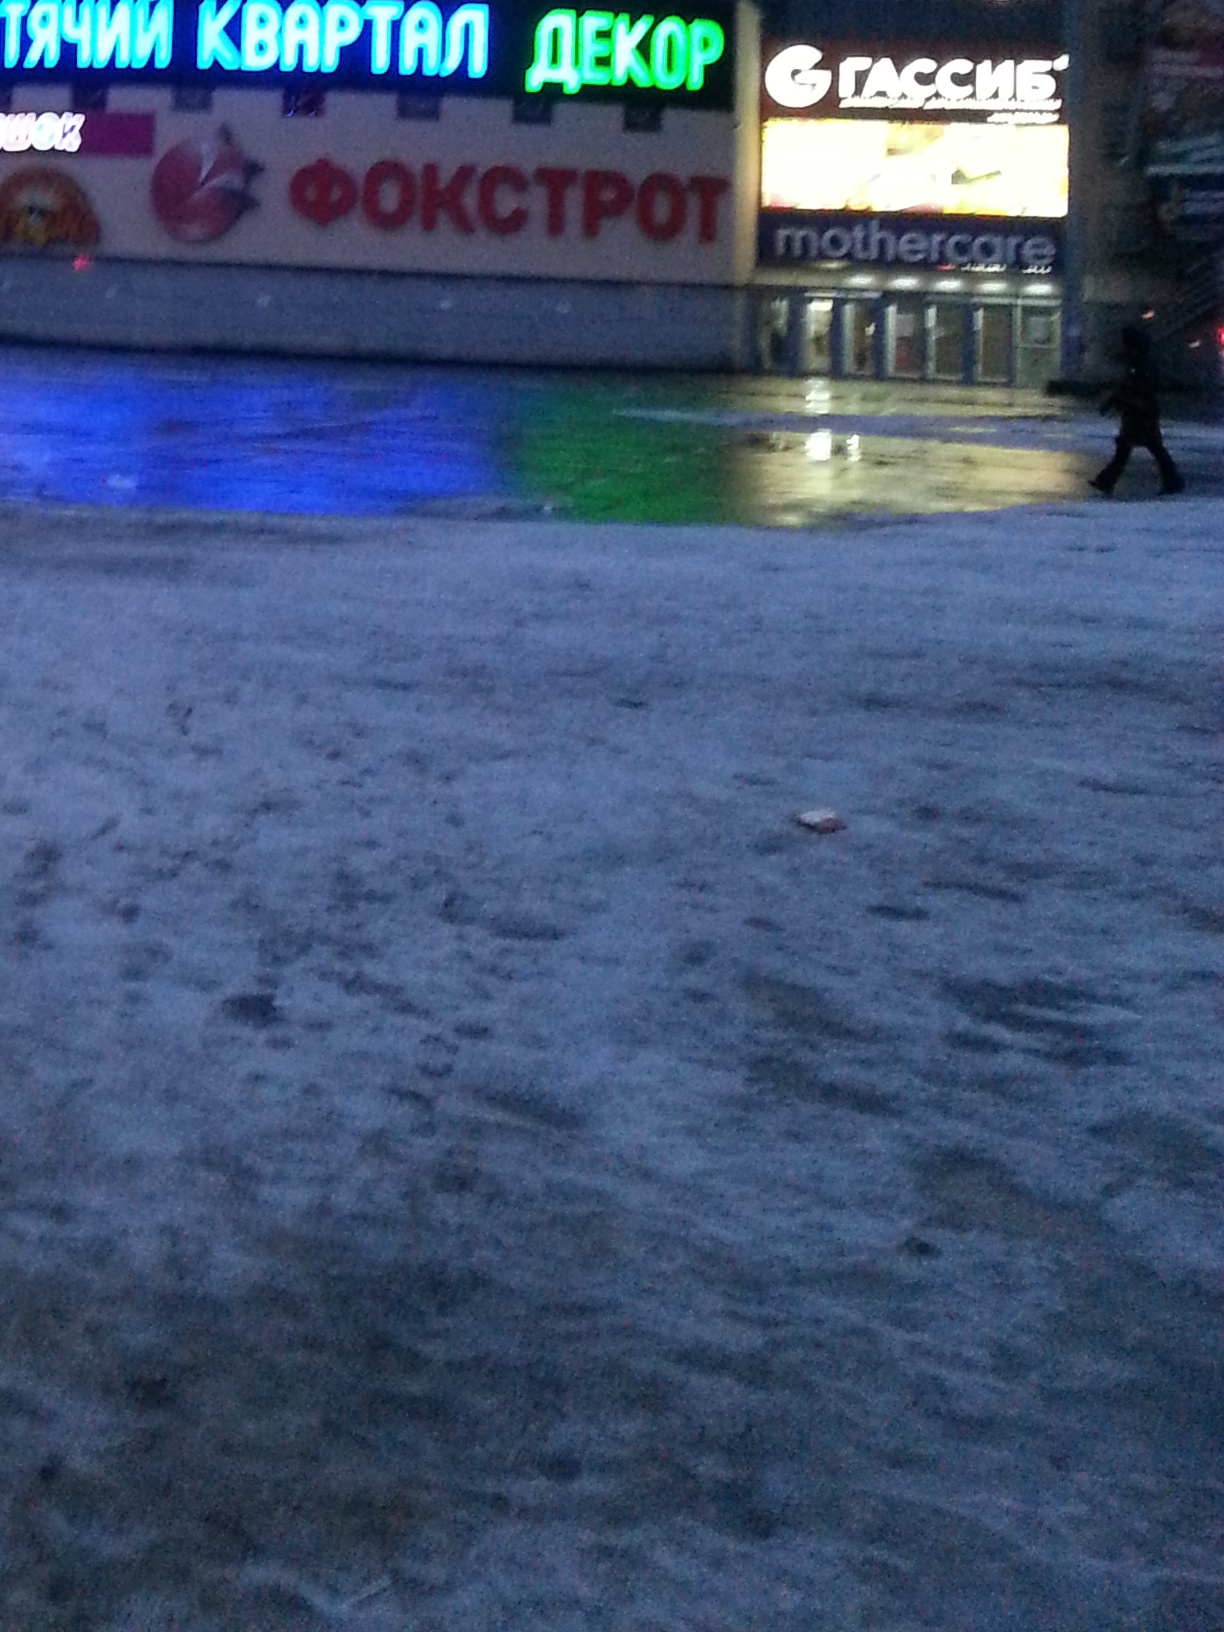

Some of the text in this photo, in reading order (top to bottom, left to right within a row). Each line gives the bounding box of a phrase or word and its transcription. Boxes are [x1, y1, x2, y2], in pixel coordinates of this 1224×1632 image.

[524, 7, 725, 95] ДЕКОР
[289, 156, 731, 245] ФОКСТРОТ
[776, 219, 1057, 267] mothercare
